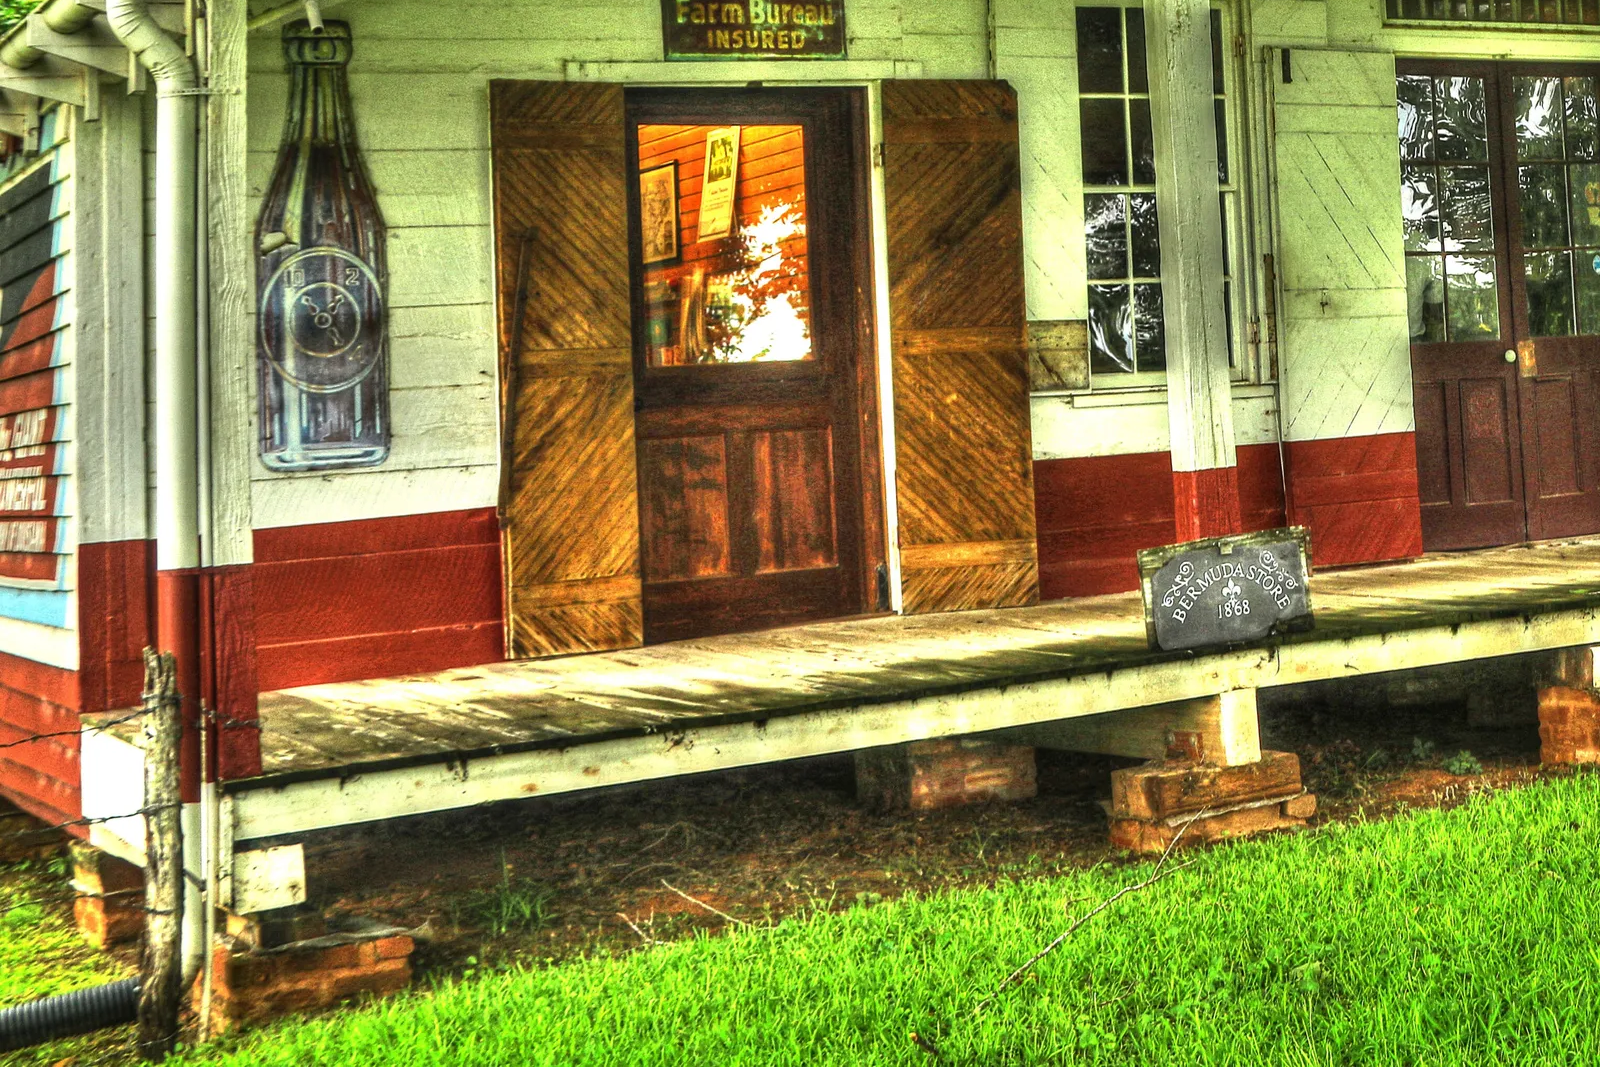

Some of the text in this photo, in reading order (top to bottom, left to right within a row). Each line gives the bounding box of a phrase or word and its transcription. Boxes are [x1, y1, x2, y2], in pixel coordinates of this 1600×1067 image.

[707, 29, 806, 50] INSURED
[345, 268, 360, 286] 2
[1172, 562, 1292, 624] BERMUDA STORE
[1218, 599, 1251, 619] 1868
